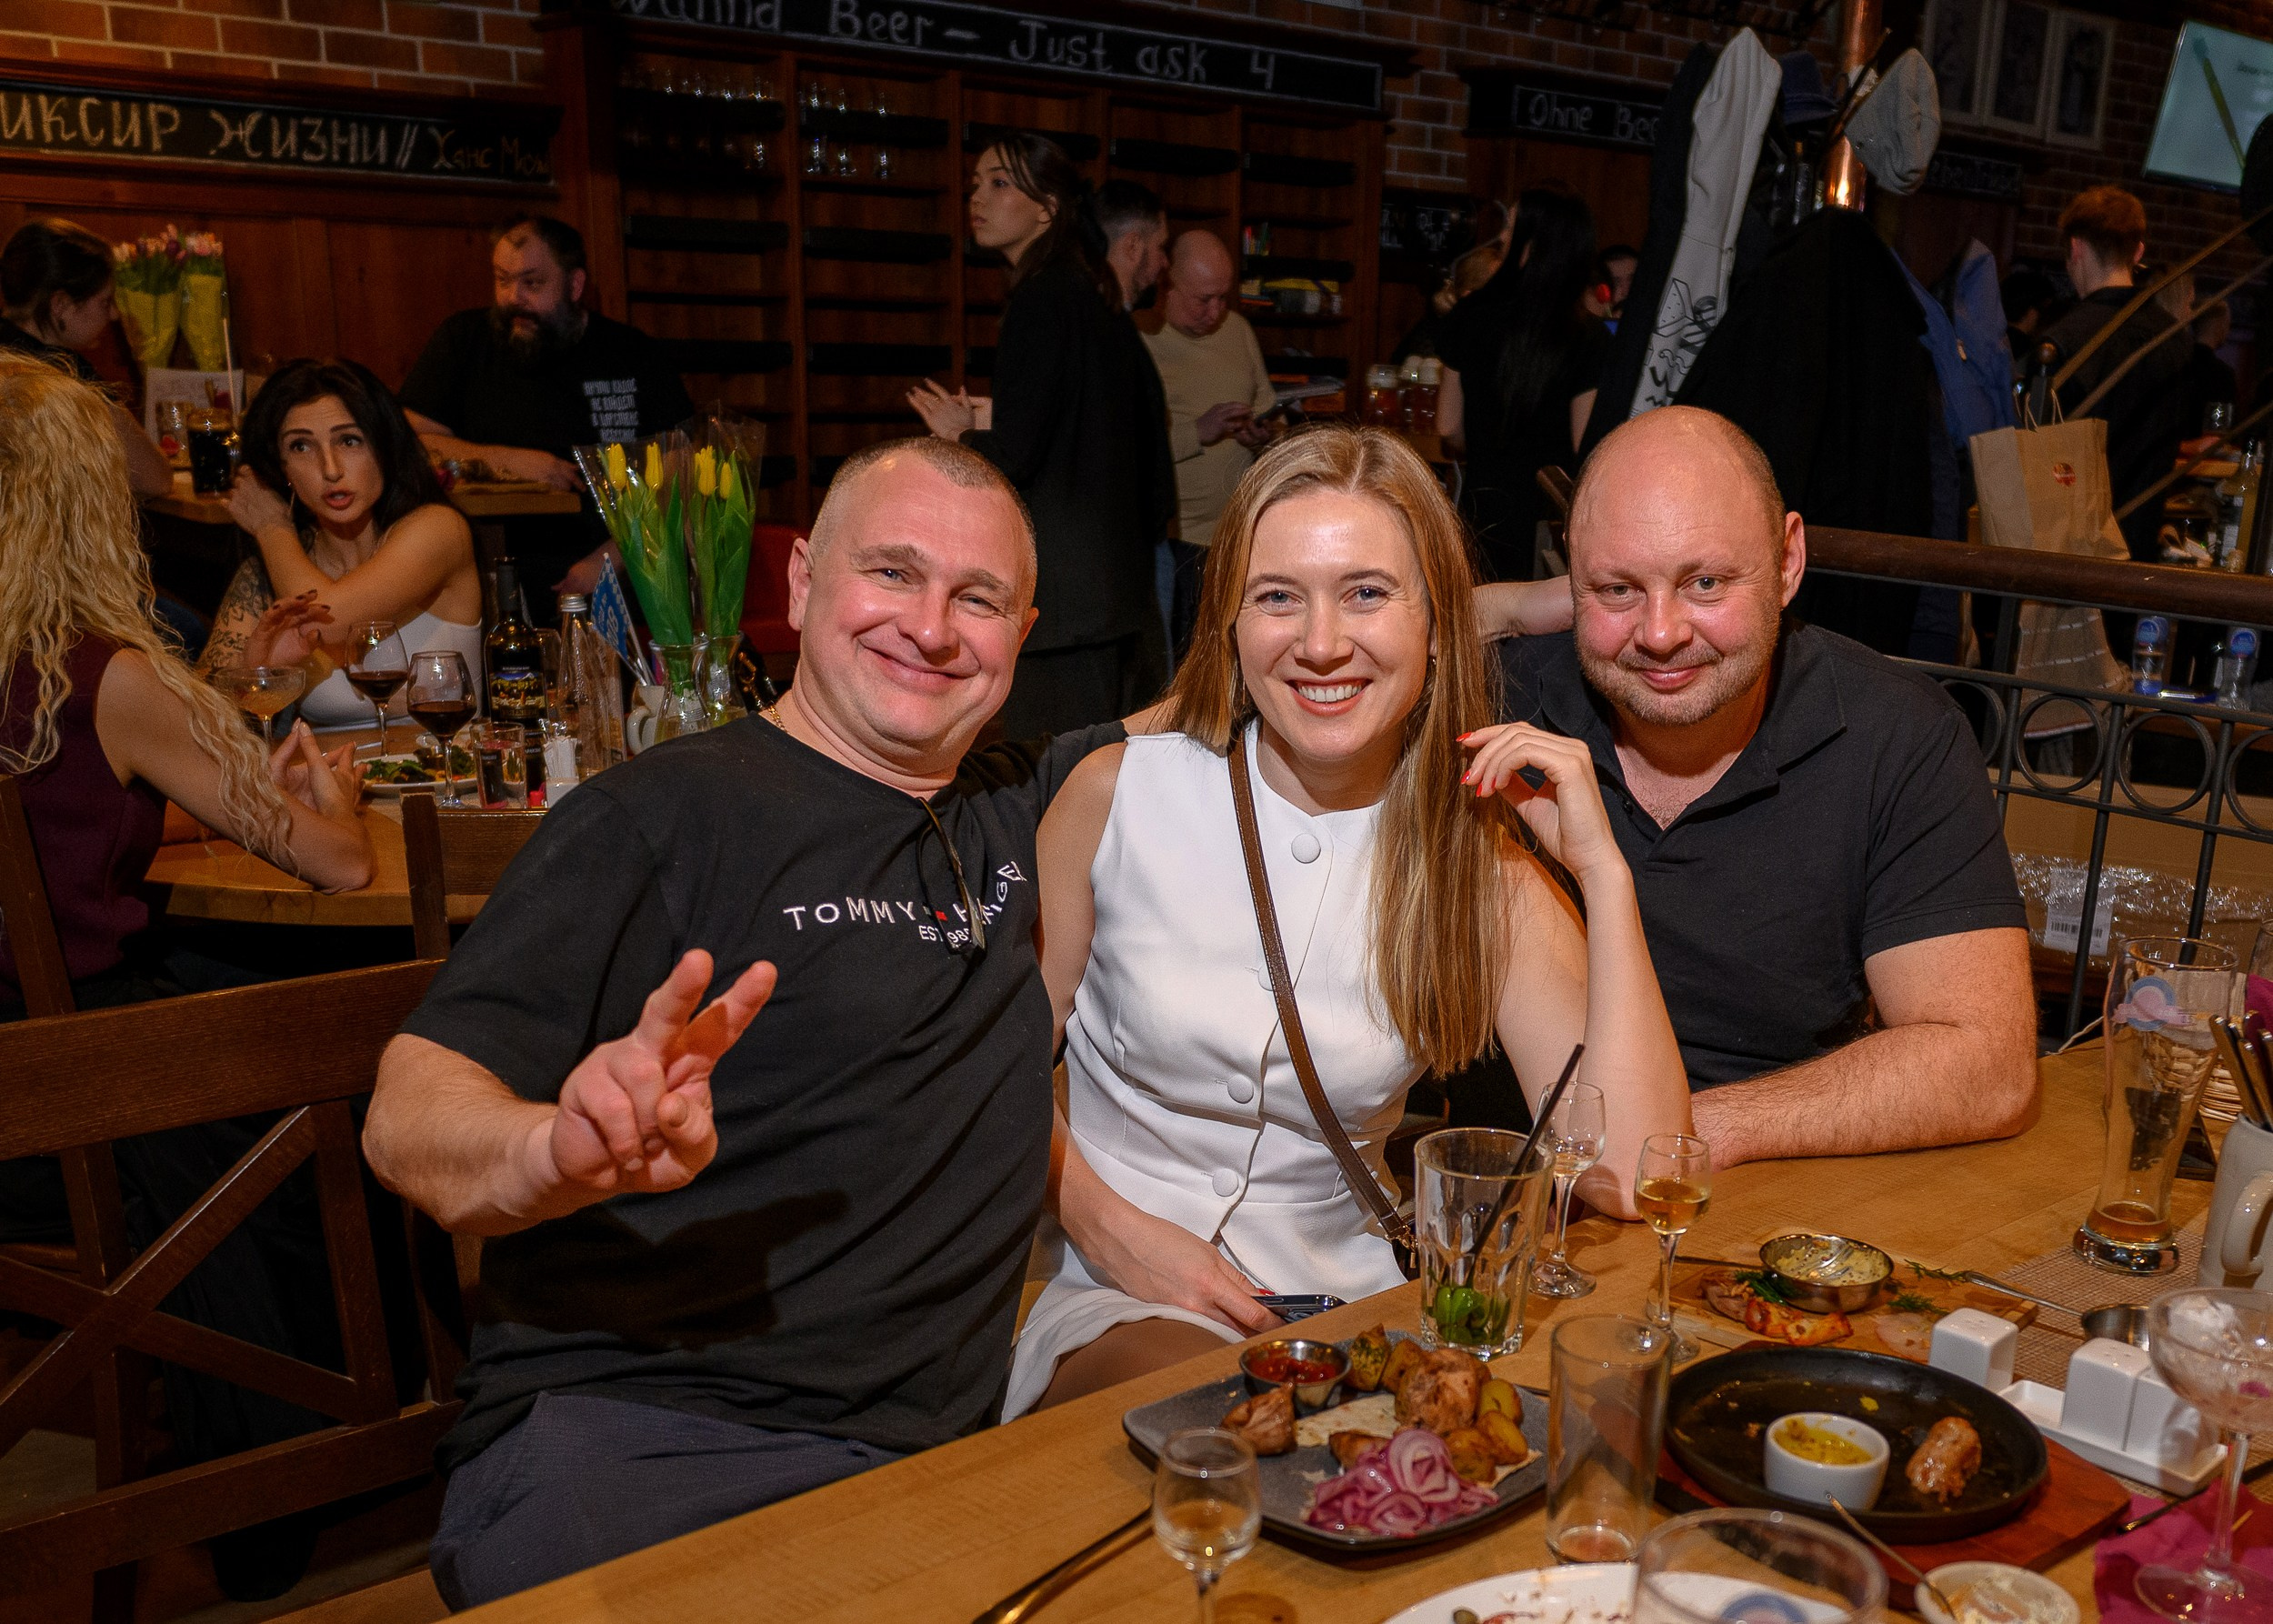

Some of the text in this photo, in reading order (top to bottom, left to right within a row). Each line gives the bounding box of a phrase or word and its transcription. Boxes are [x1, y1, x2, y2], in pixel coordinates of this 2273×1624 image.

[826, 0, 936, 46] Beer
[1008, 19, 1114, 72] Just
[1136, 41, 1208, 84] ask
[1248, 49, 1277, 90] 4
[1528, 92, 1594, 131] Ohne
[782, 896, 917, 931] TOMMY
